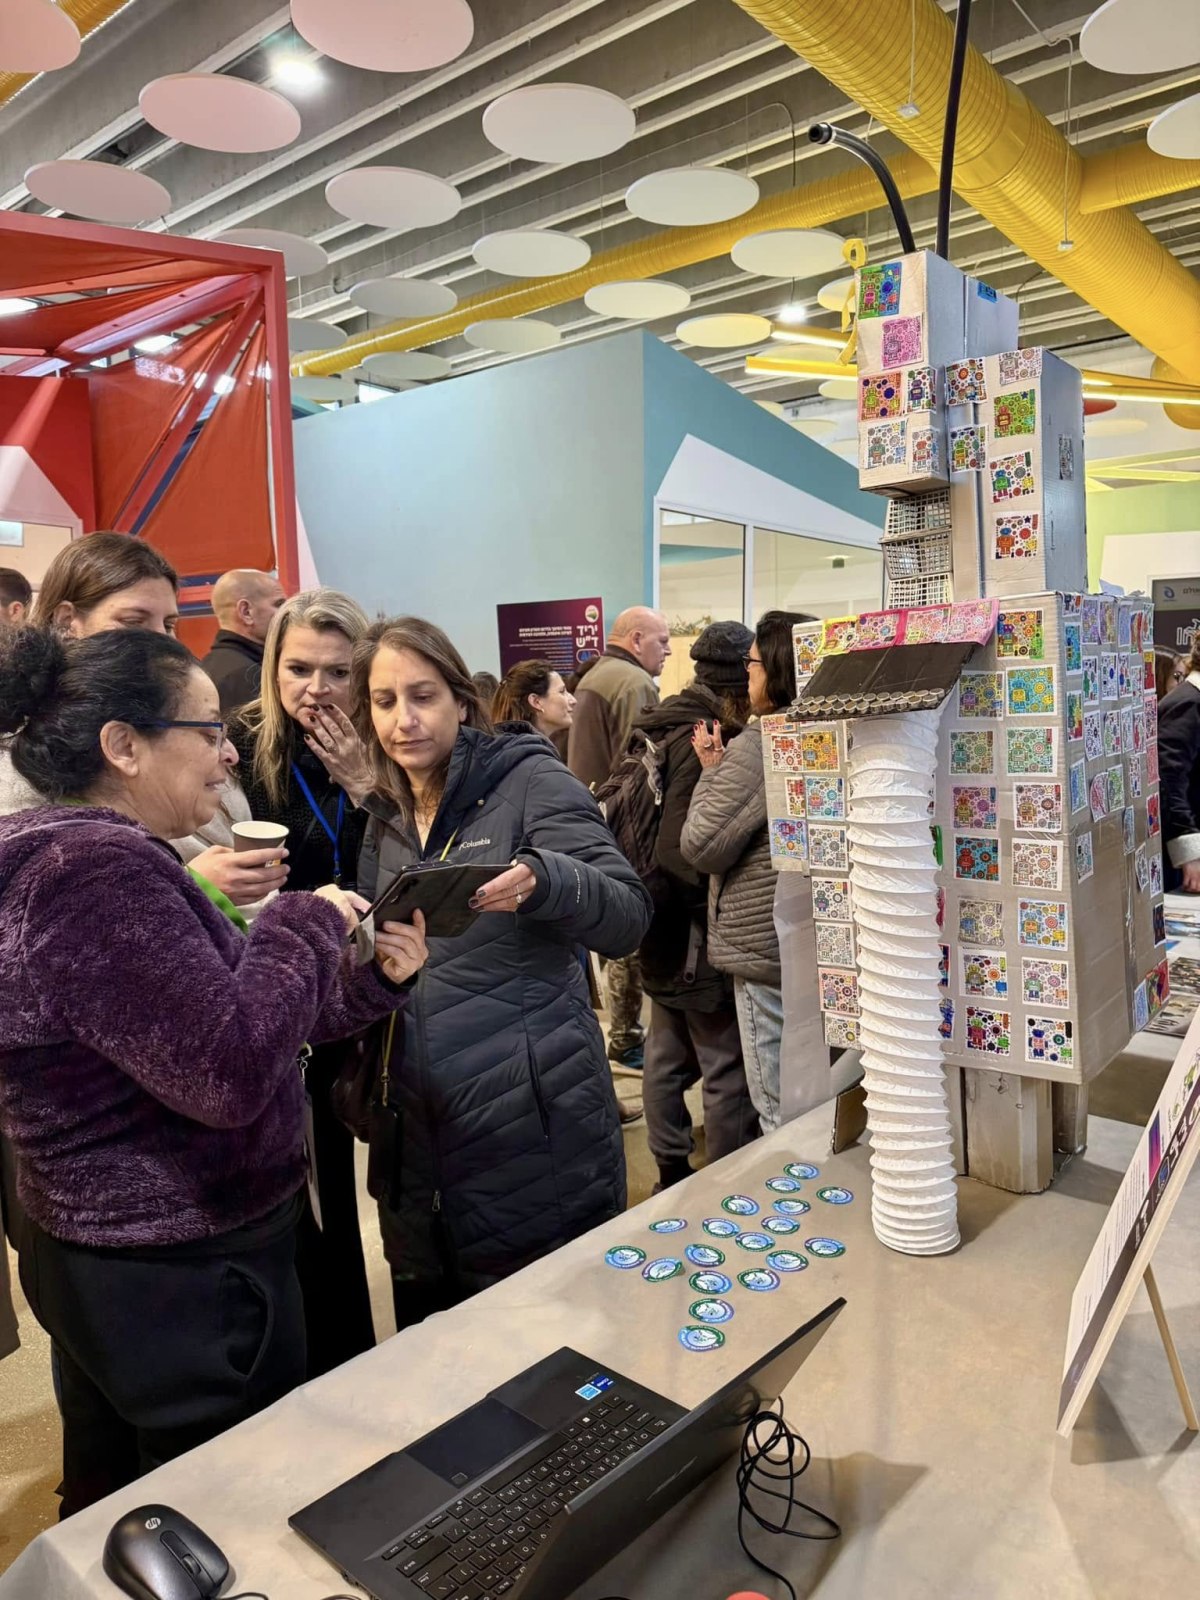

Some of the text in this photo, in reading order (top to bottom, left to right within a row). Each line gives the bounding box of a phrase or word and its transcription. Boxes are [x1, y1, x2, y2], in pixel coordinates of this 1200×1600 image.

[576, 625, 598, 636] יריד
[461, 837, 491, 849] Columbia
[146, 1517, 161, 1529] hp
